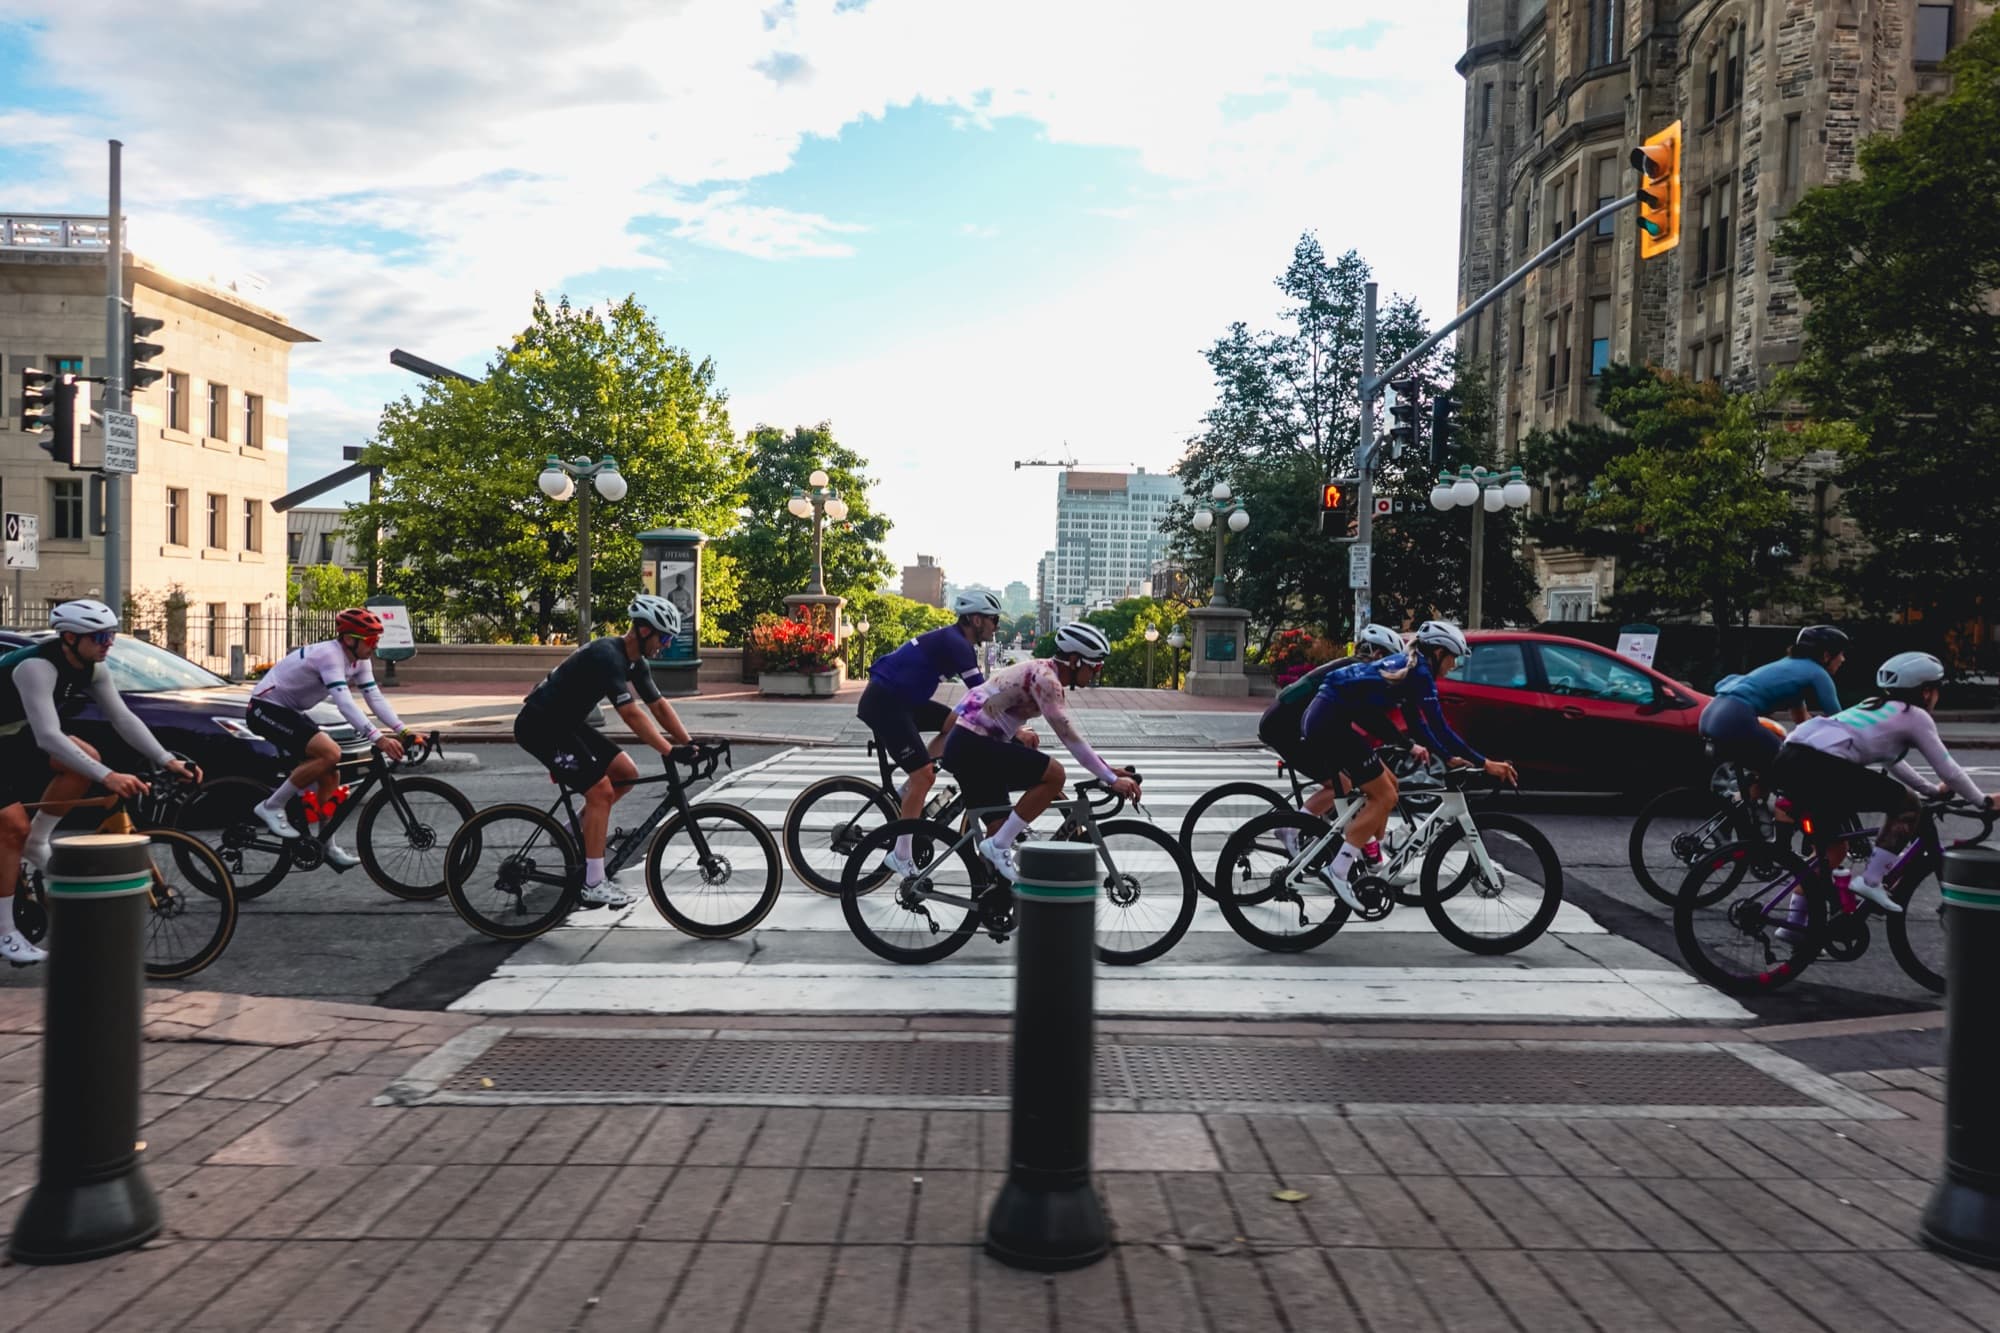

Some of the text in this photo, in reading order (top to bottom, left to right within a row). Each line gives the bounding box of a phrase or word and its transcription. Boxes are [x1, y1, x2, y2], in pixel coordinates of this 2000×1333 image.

[108, 414, 135, 428] BICYCLE
[110, 427, 133, 439] SIGNAL
[106, 444, 136, 458] FEUX POUR
[107, 456, 136, 470] CYCLISTES
[664, 551, 690, 559] OTTAWA
[1387, 816, 1446, 882] SAVA
